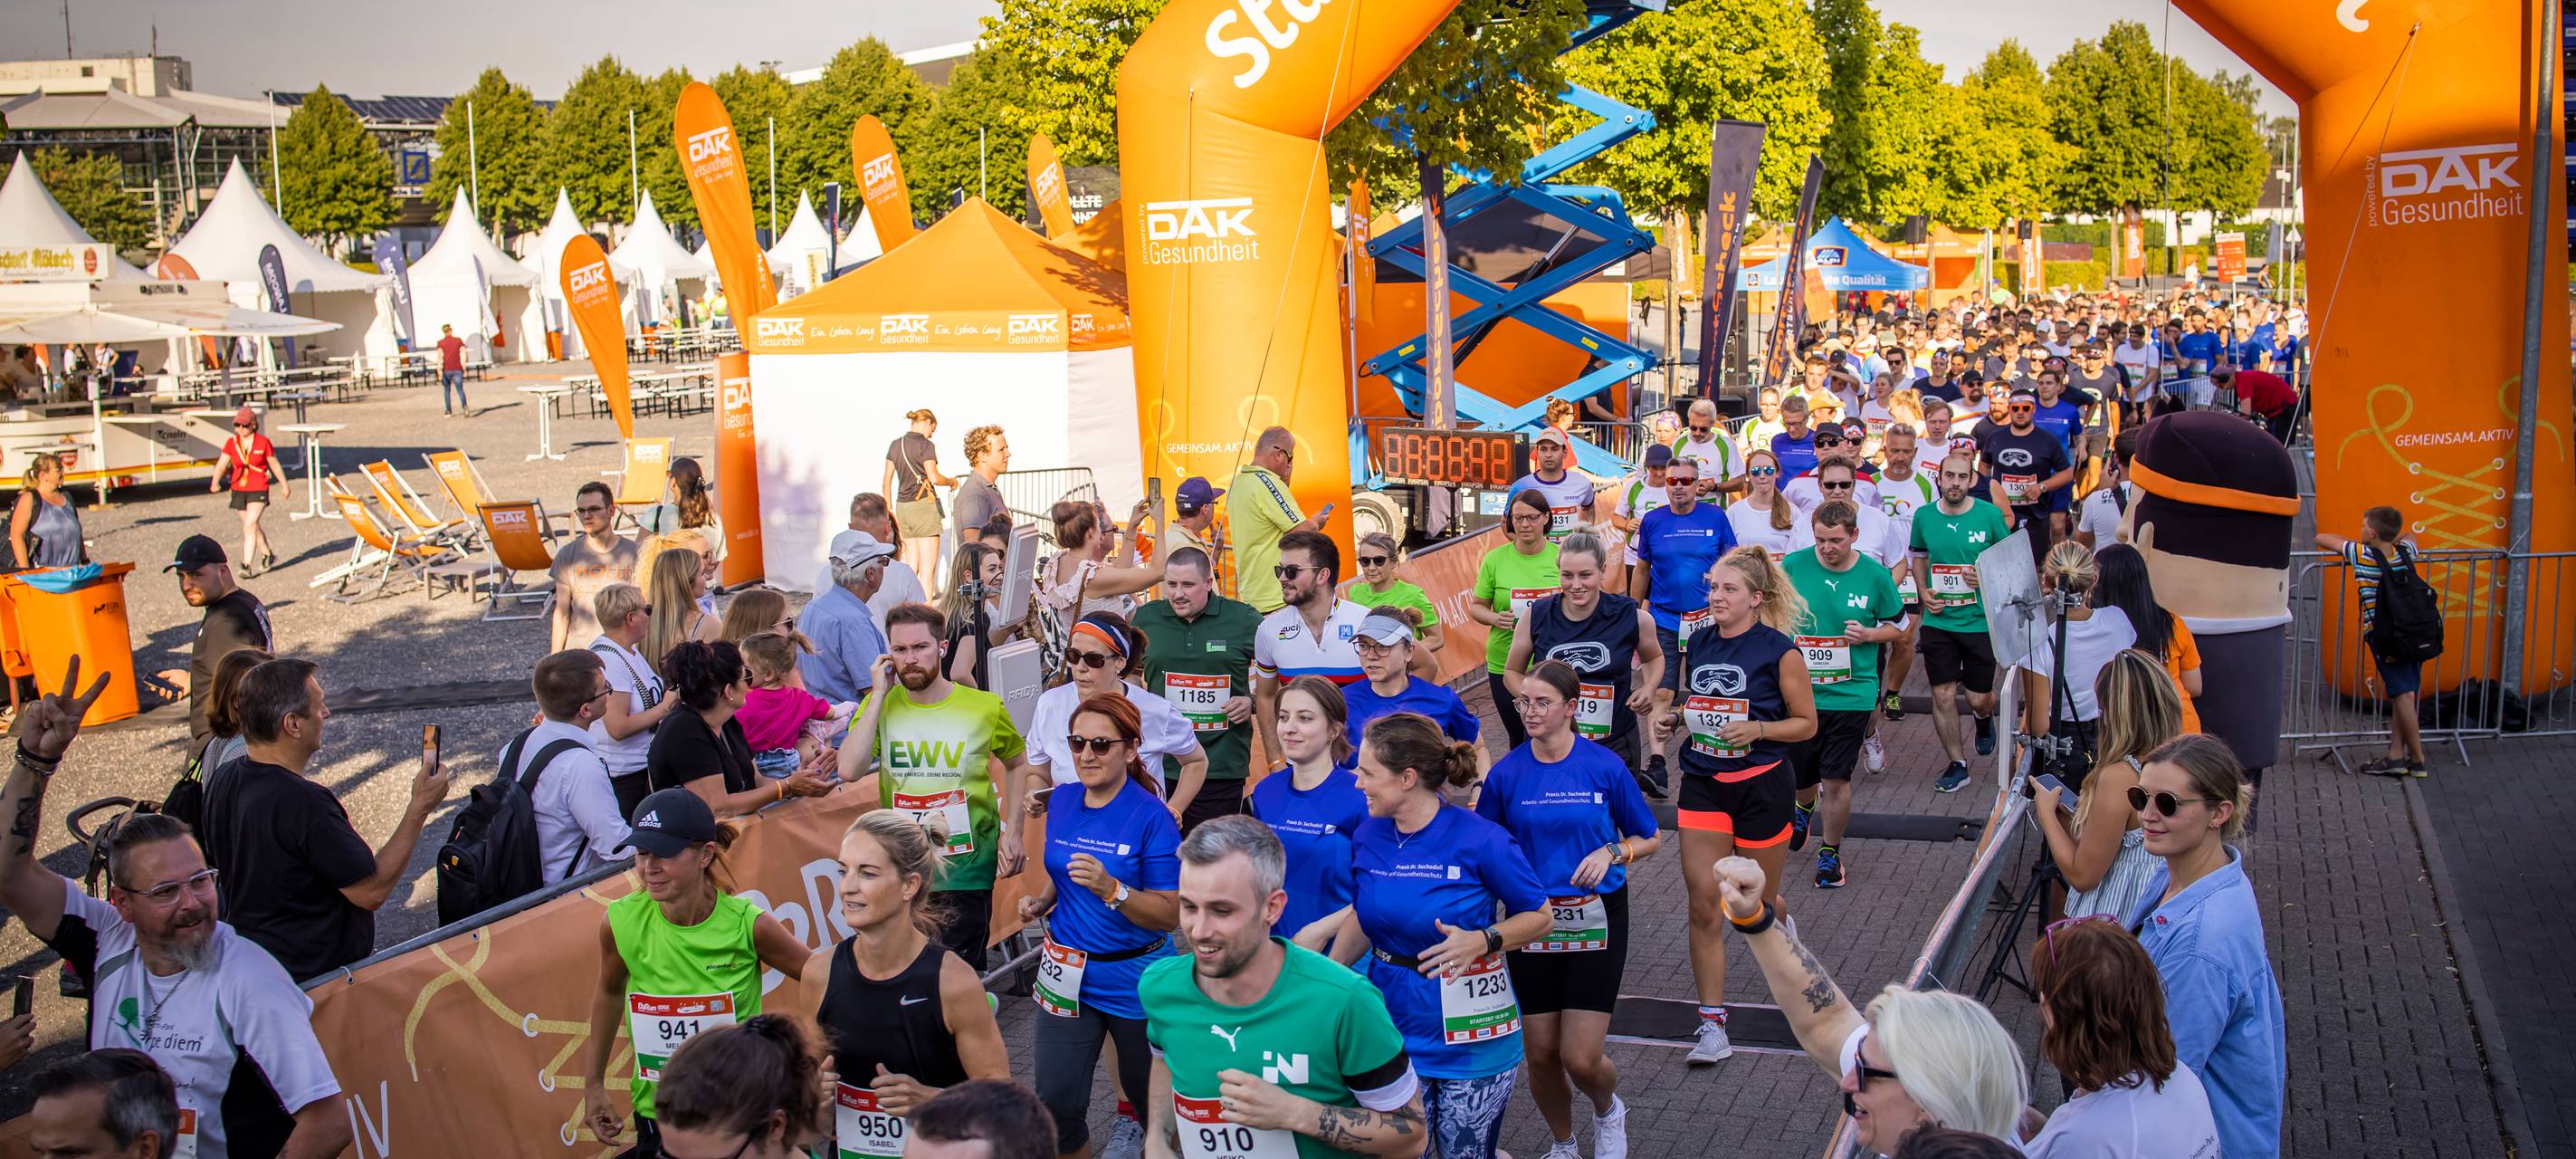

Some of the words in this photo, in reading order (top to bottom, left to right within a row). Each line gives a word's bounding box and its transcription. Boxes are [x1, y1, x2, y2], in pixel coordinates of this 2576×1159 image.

[1205, 0, 1331, 88] Sta
[688, 126, 731, 163] DAK
[863, 152, 895, 187] DAK
[2380, 142, 2522, 197] DAK
[2364, 174, 2379, 226] powered
[2382, 189, 2523, 225] Gesundheit
[1146, 197, 1257, 241] DAK
[1139, 219, 1150, 264] powered
[1150, 237, 1260, 264] Gesundheit
[569, 260, 608, 292] DAK
[1842, 274, 1887, 286] Qualität
[757, 317, 804, 336] DAK
[881, 314, 930, 334] DAK
[1008, 313, 1058, 334] DAK
[1072, 313, 1094, 332] DAK
[758, 336, 805, 347] Gesundheit
[880, 333, 930, 345] Gesundheit
[1008, 333, 1060, 345] Gesundheit
[724, 376, 753, 410] DA
[1166, 442, 1223, 454] GEMEINSAM.
[1224, 441, 1255, 452] AKTIV
[2395, 431, 2476, 447] GEMEINSAM.
[2477, 428, 2514, 442] AKTIV
[491, 510, 527, 525] DAK
[1551, 515, 1569, 525] 431
[1943, 575, 1959, 586] 901
[1688, 618, 1710, 633] 1227
[1808, 649, 1833, 661] 909
[1179, 689, 1216, 704] 1185
[1697, 713, 1731, 727] 1321
[890, 741, 967, 769] EWV
[1397, 870, 1443, 879] Gesundheitsschutz
[1553, 908, 1585, 921] 231
[1041, 953, 1063, 982] 232
[1464, 972, 1507, 999] 1233
[658, 1020, 700, 1040] 941
[858, 1115, 903, 1139] 950
[869, 1139, 897, 1148] ISABEL
[1199, 1126, 1254, 1152] 910
